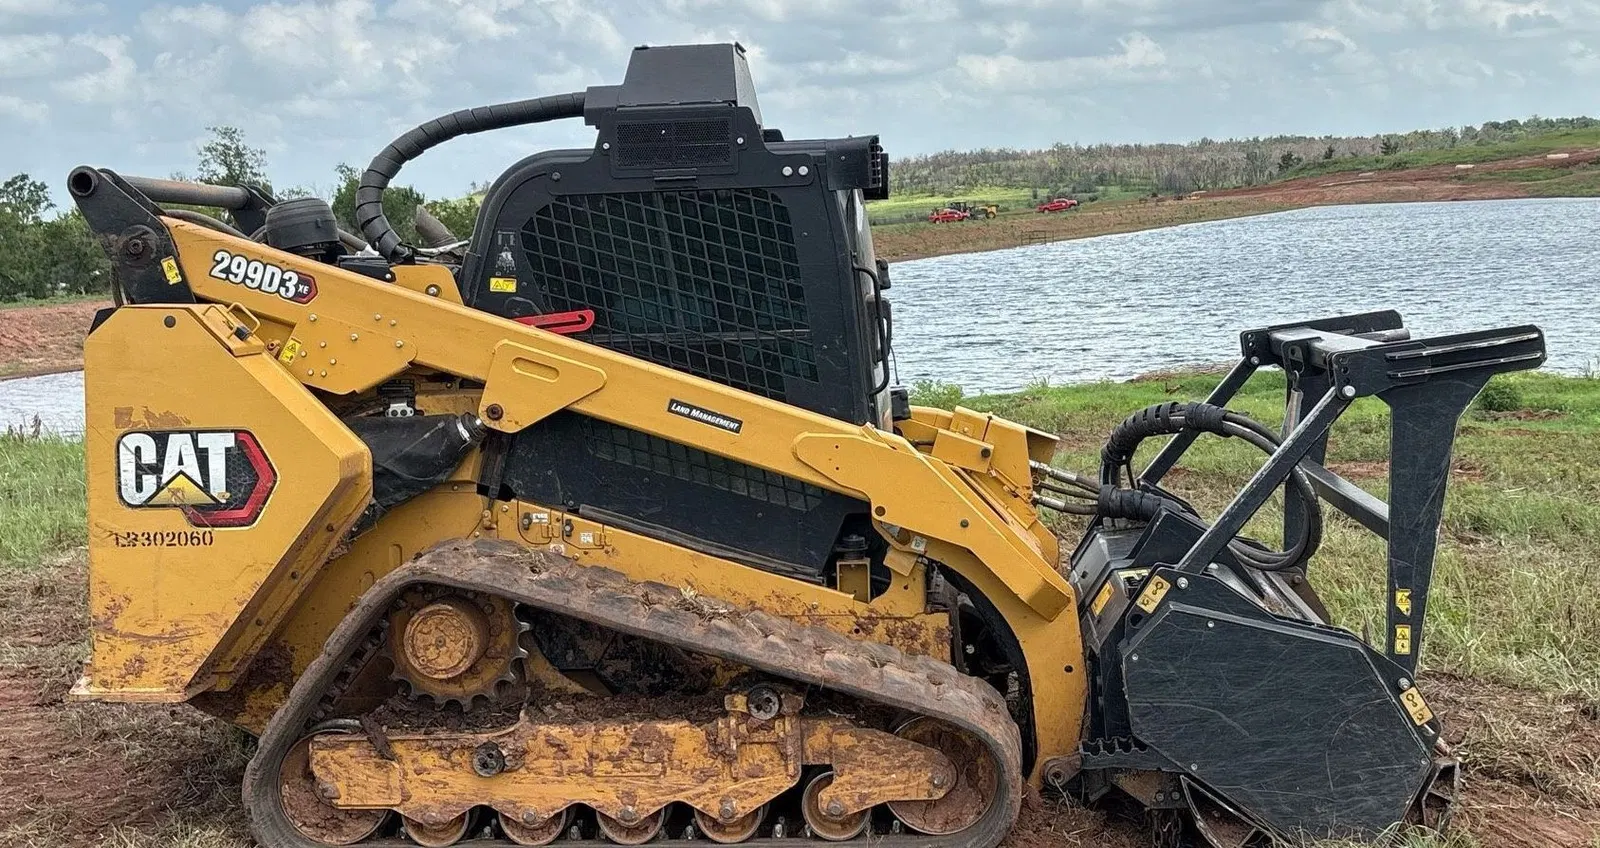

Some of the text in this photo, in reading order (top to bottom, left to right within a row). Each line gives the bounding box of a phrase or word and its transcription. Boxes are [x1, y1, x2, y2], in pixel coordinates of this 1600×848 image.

[210, 250, 310, 299] 299D3 XE
[670, 402, 740, 431] LAND MANAGEMENT
[119, 432, 236, 505] CAT
